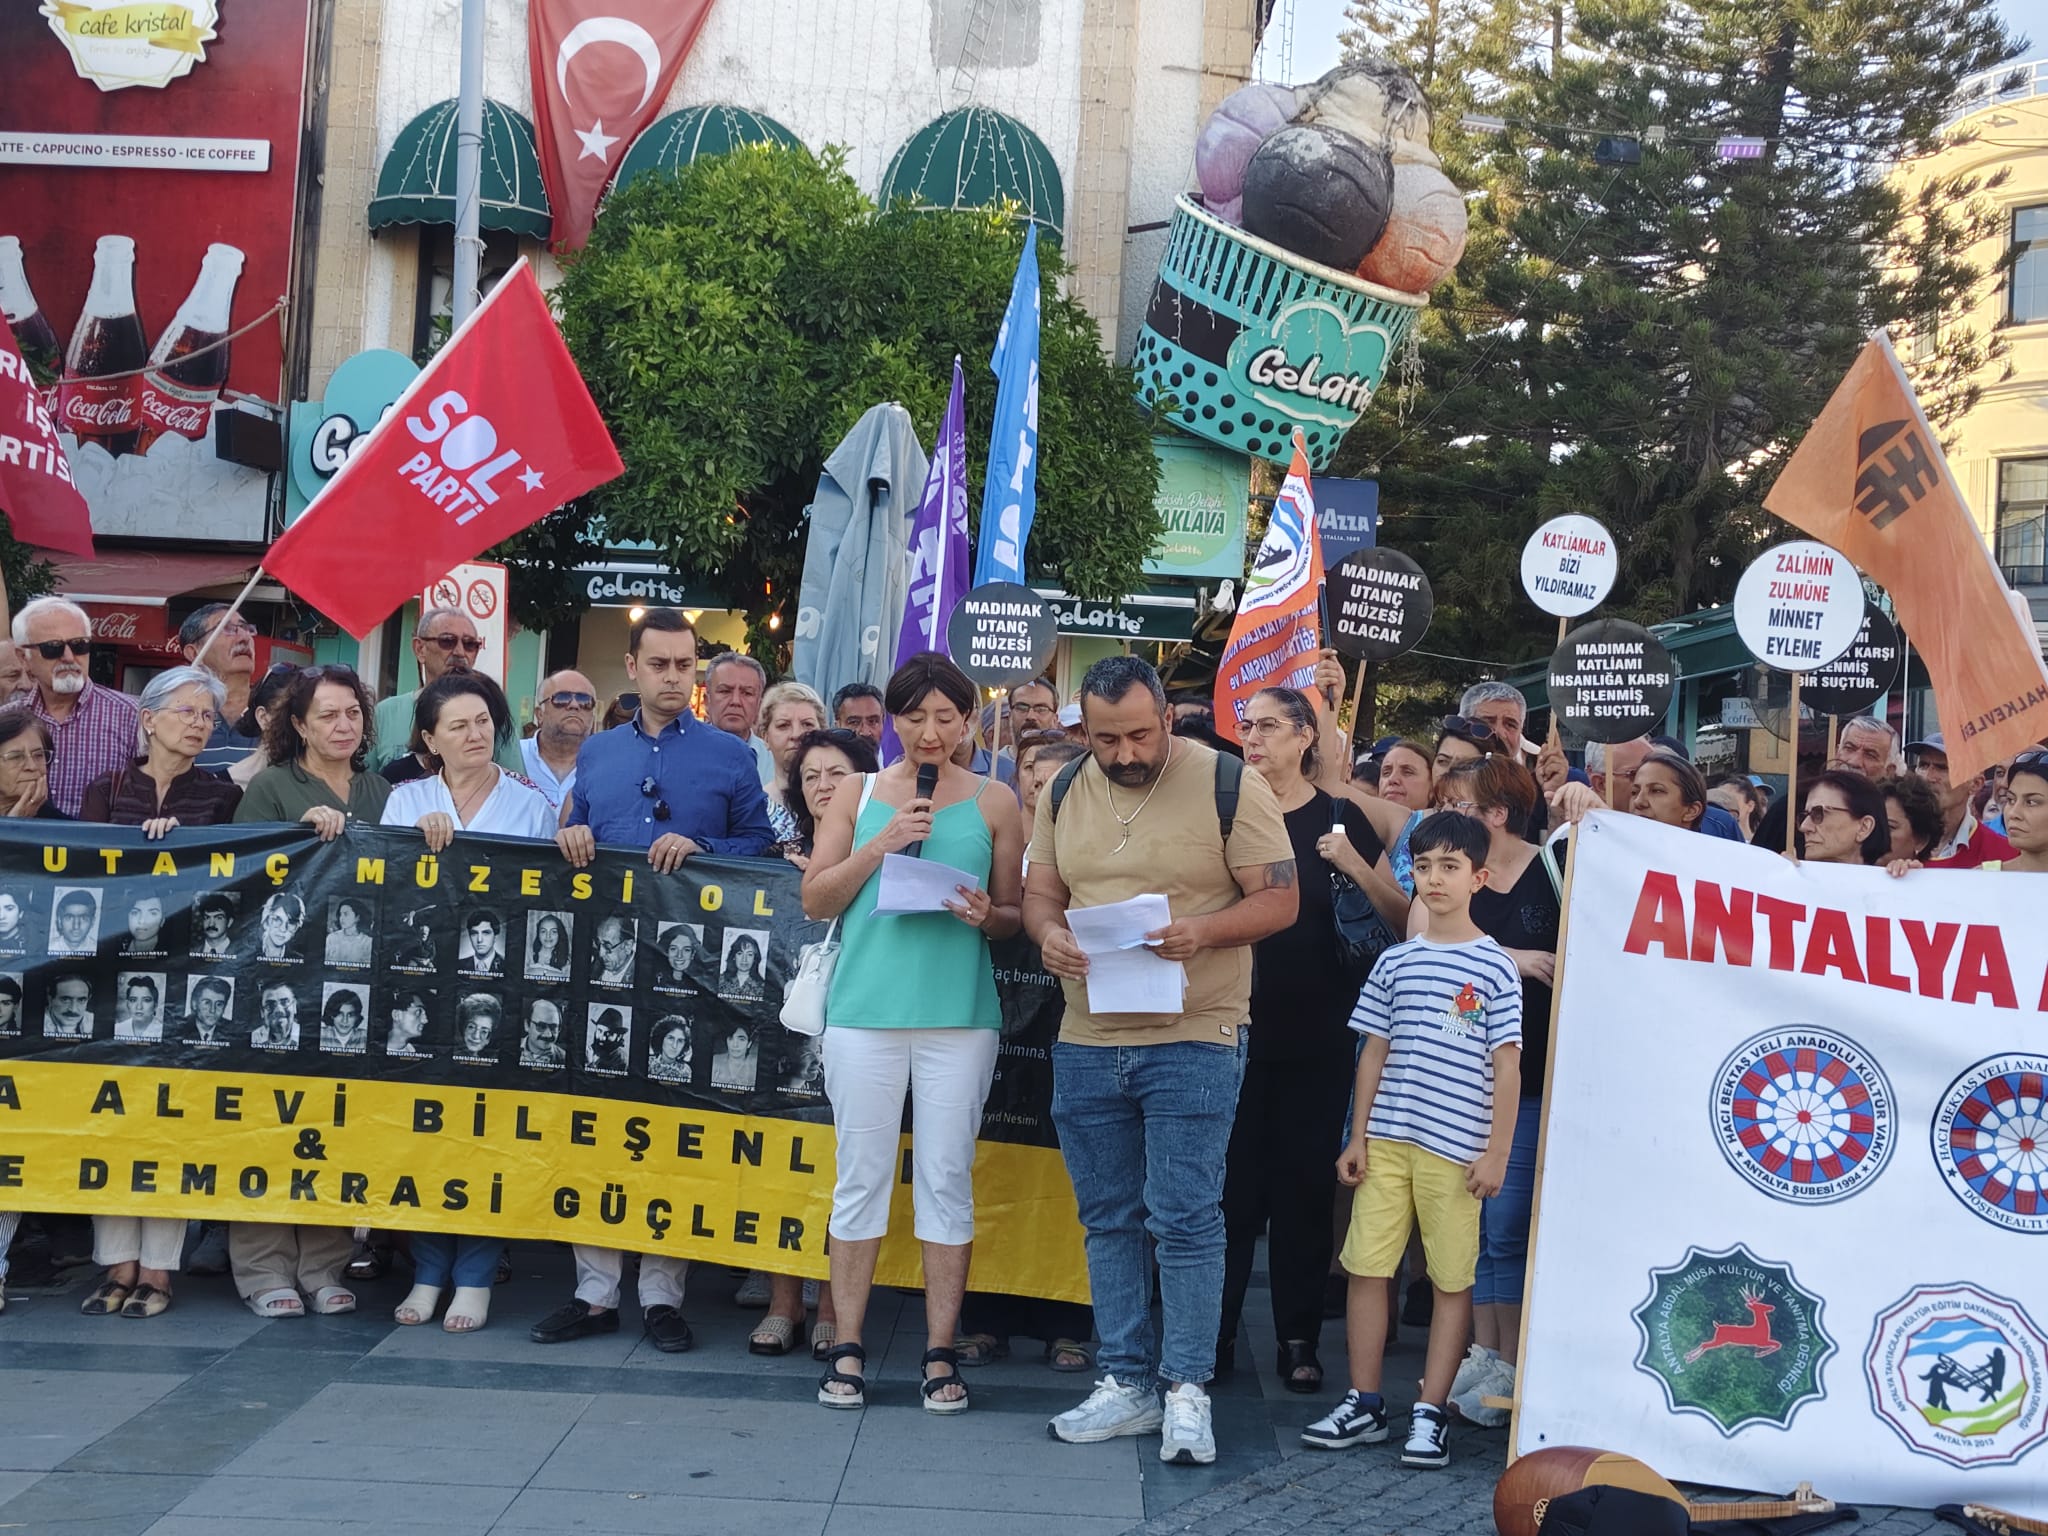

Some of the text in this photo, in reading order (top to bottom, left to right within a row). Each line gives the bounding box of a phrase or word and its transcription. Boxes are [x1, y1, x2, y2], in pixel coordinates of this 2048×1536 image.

[79, 10, 187, 35] cafe kristal
[0, 142, 256, 161] TTE CAPPUCINO ESPRESSO ICE COFFEE
[406, 390, 522, 506] SOL
[398, 451, 485, 526] PARTİ
[1157, 507, 1227, 535] AKLAVA
[1542, 530, 1606, 556] KATLİAMLAR
[1559, 554, 1582, 575] BİZİ
[1776, 549, 1834, 577] ZALİMİN
[1341, 563, 1421, 591] MADIMAK
[1535, 576, 1597, 600] YILDIRAMAZ
[1350, 583, 1403, 609] UTANÇ
[1769, 580, 1830, 602] ZULMÜNE
[965, 601, 1042, 617] MADIMAK
[1342, 601, 1405, 625] MÜZESİ
[1768, 602, 1823, 630] MİNNET
[977, 618, 1028, 637] UTANÇ
[1337, 620, 1402, 644] OLACAK
[971, 634, 1032, 652] MÜZESİ
[1576, 643, 1644, 656] MADIMAK
[1766, 637, 1822, 660] EYLEME
[970, 653, 1032, 670] OLACAK
[1577, 656, 1642, 670] KATLİAMI
[1854, 647, 1895, 665] KARŞI
[1551, 673, 1669, 689] İNSANLIĞA KARŞI
[1821, 676, 1880, 690] SUÇTUR.
[1577, 687, 1643, 703] İŞLENMİŞ
[1566, 704, 1655, 719] BİR SUÇTUR.
[43, 846, 775, 917] UTANÇ MÜZESİ OL
[1623, 870, 2019, 1010] ANTALYA
[1978, 1060, 2010, 1080] VELİ
[1720, 1036, 1887, 1163] HACI BEKTAŞ VELİ ANADOLU KÜLTÜR VAKFI
[1941, 1078, 1979, 1123] BEKTAŞ
[91, 1080, 347, 1127] ALEVİ
[413, 1093, 912, 1184] BİLEŞENL
[293, 1128, 328, 1161] &
[1937, 1127, 1950, 1161] HACI
[1743, 1159, 1862, 1196] ANTALYA ŞUBESİ 1994
[79, 1158, 502, 1213] DEMOKRASİ
[554, 1183, 831, 1255] GÜÇLER
[1903, 1306, 1931, 1330] KÜLTÜR
[1931, 1299, 1962, 1312] EĞİTİM
[1963, 1302, 2011, 1329] DAYANIŞMA
[1658, 1264, 1810, 1394] ANTALYA ABDAL MUSA KÜLTÜR VE TANITMA DERNEĞİ
[1885, 1330, 1905, 1375] TAHTACILARI
[2017, 1336, 2042, 1396] YARDIMLAŞMA
[1887, 1377, 1906, 1412] ANTALYA
[1934, 1431, 1995, 1447] ANTALYA 2013
